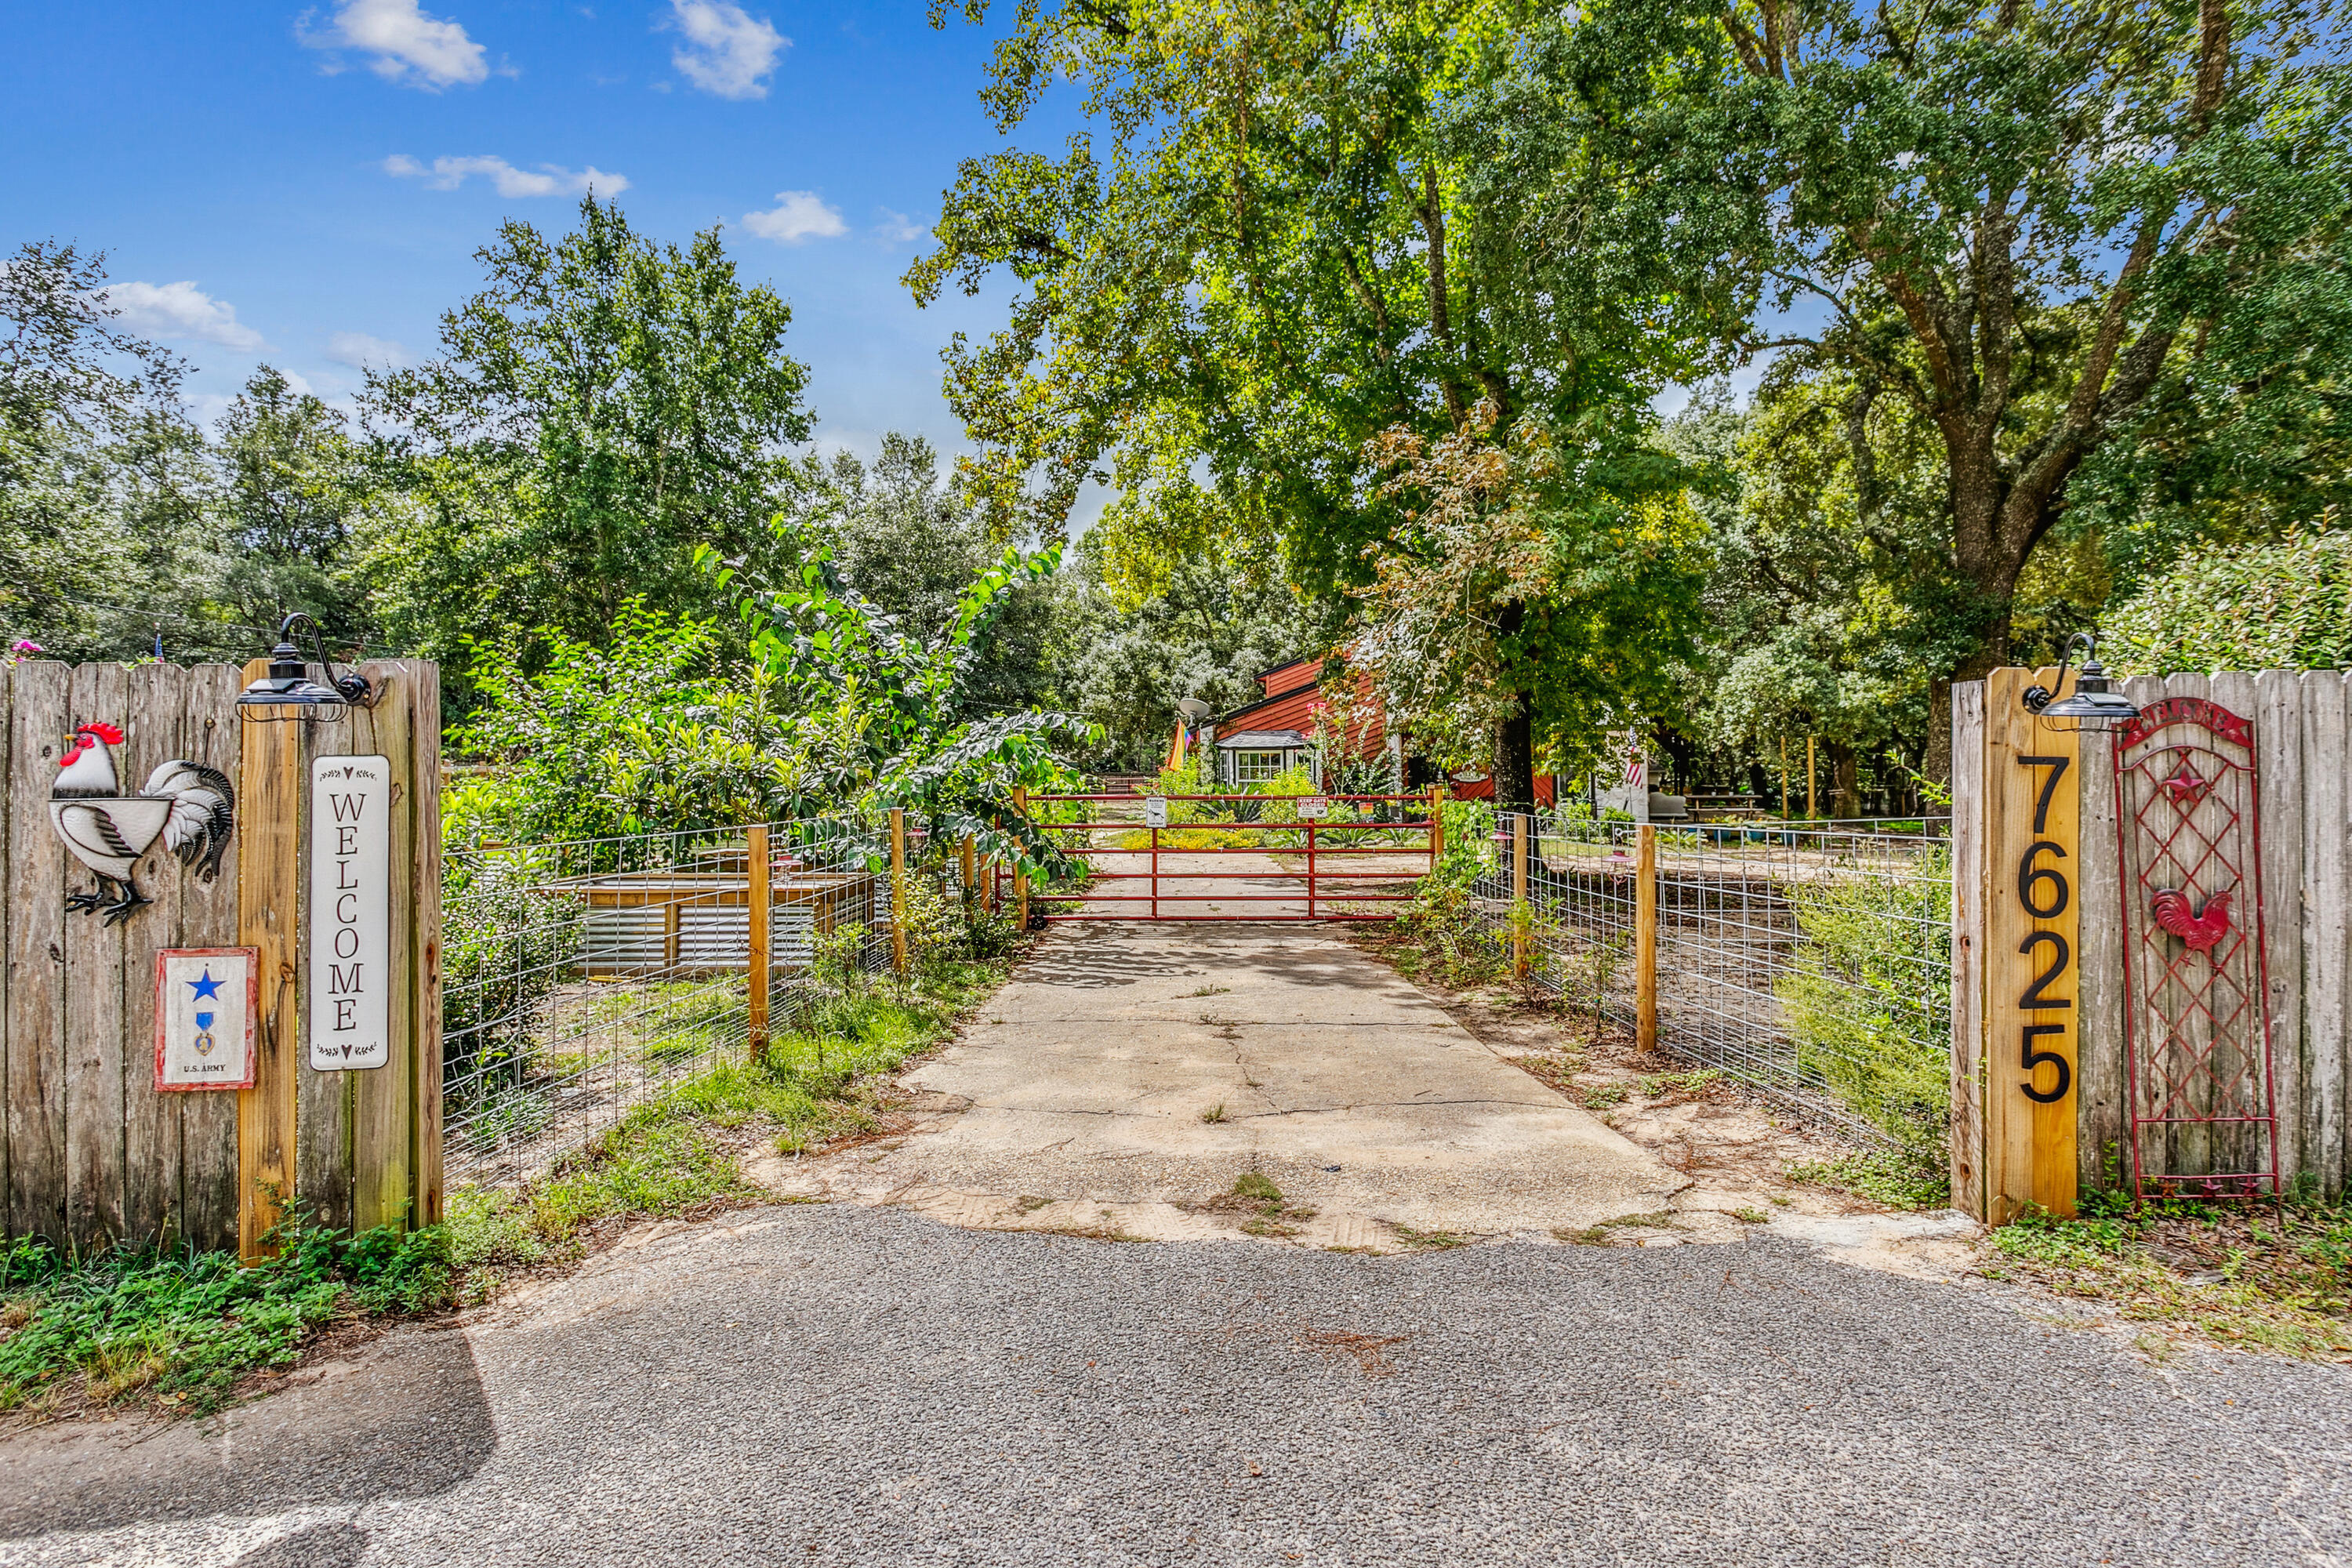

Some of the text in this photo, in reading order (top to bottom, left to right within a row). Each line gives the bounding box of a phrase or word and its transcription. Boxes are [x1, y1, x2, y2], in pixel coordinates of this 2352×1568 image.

[2140, 700, 2228, 732] WELCOME
[328, 793, 367, 1032] WELCOME
[2017, 756, 2071, 1104] 7625
[201, 1064, 226, 1073] ARMY
